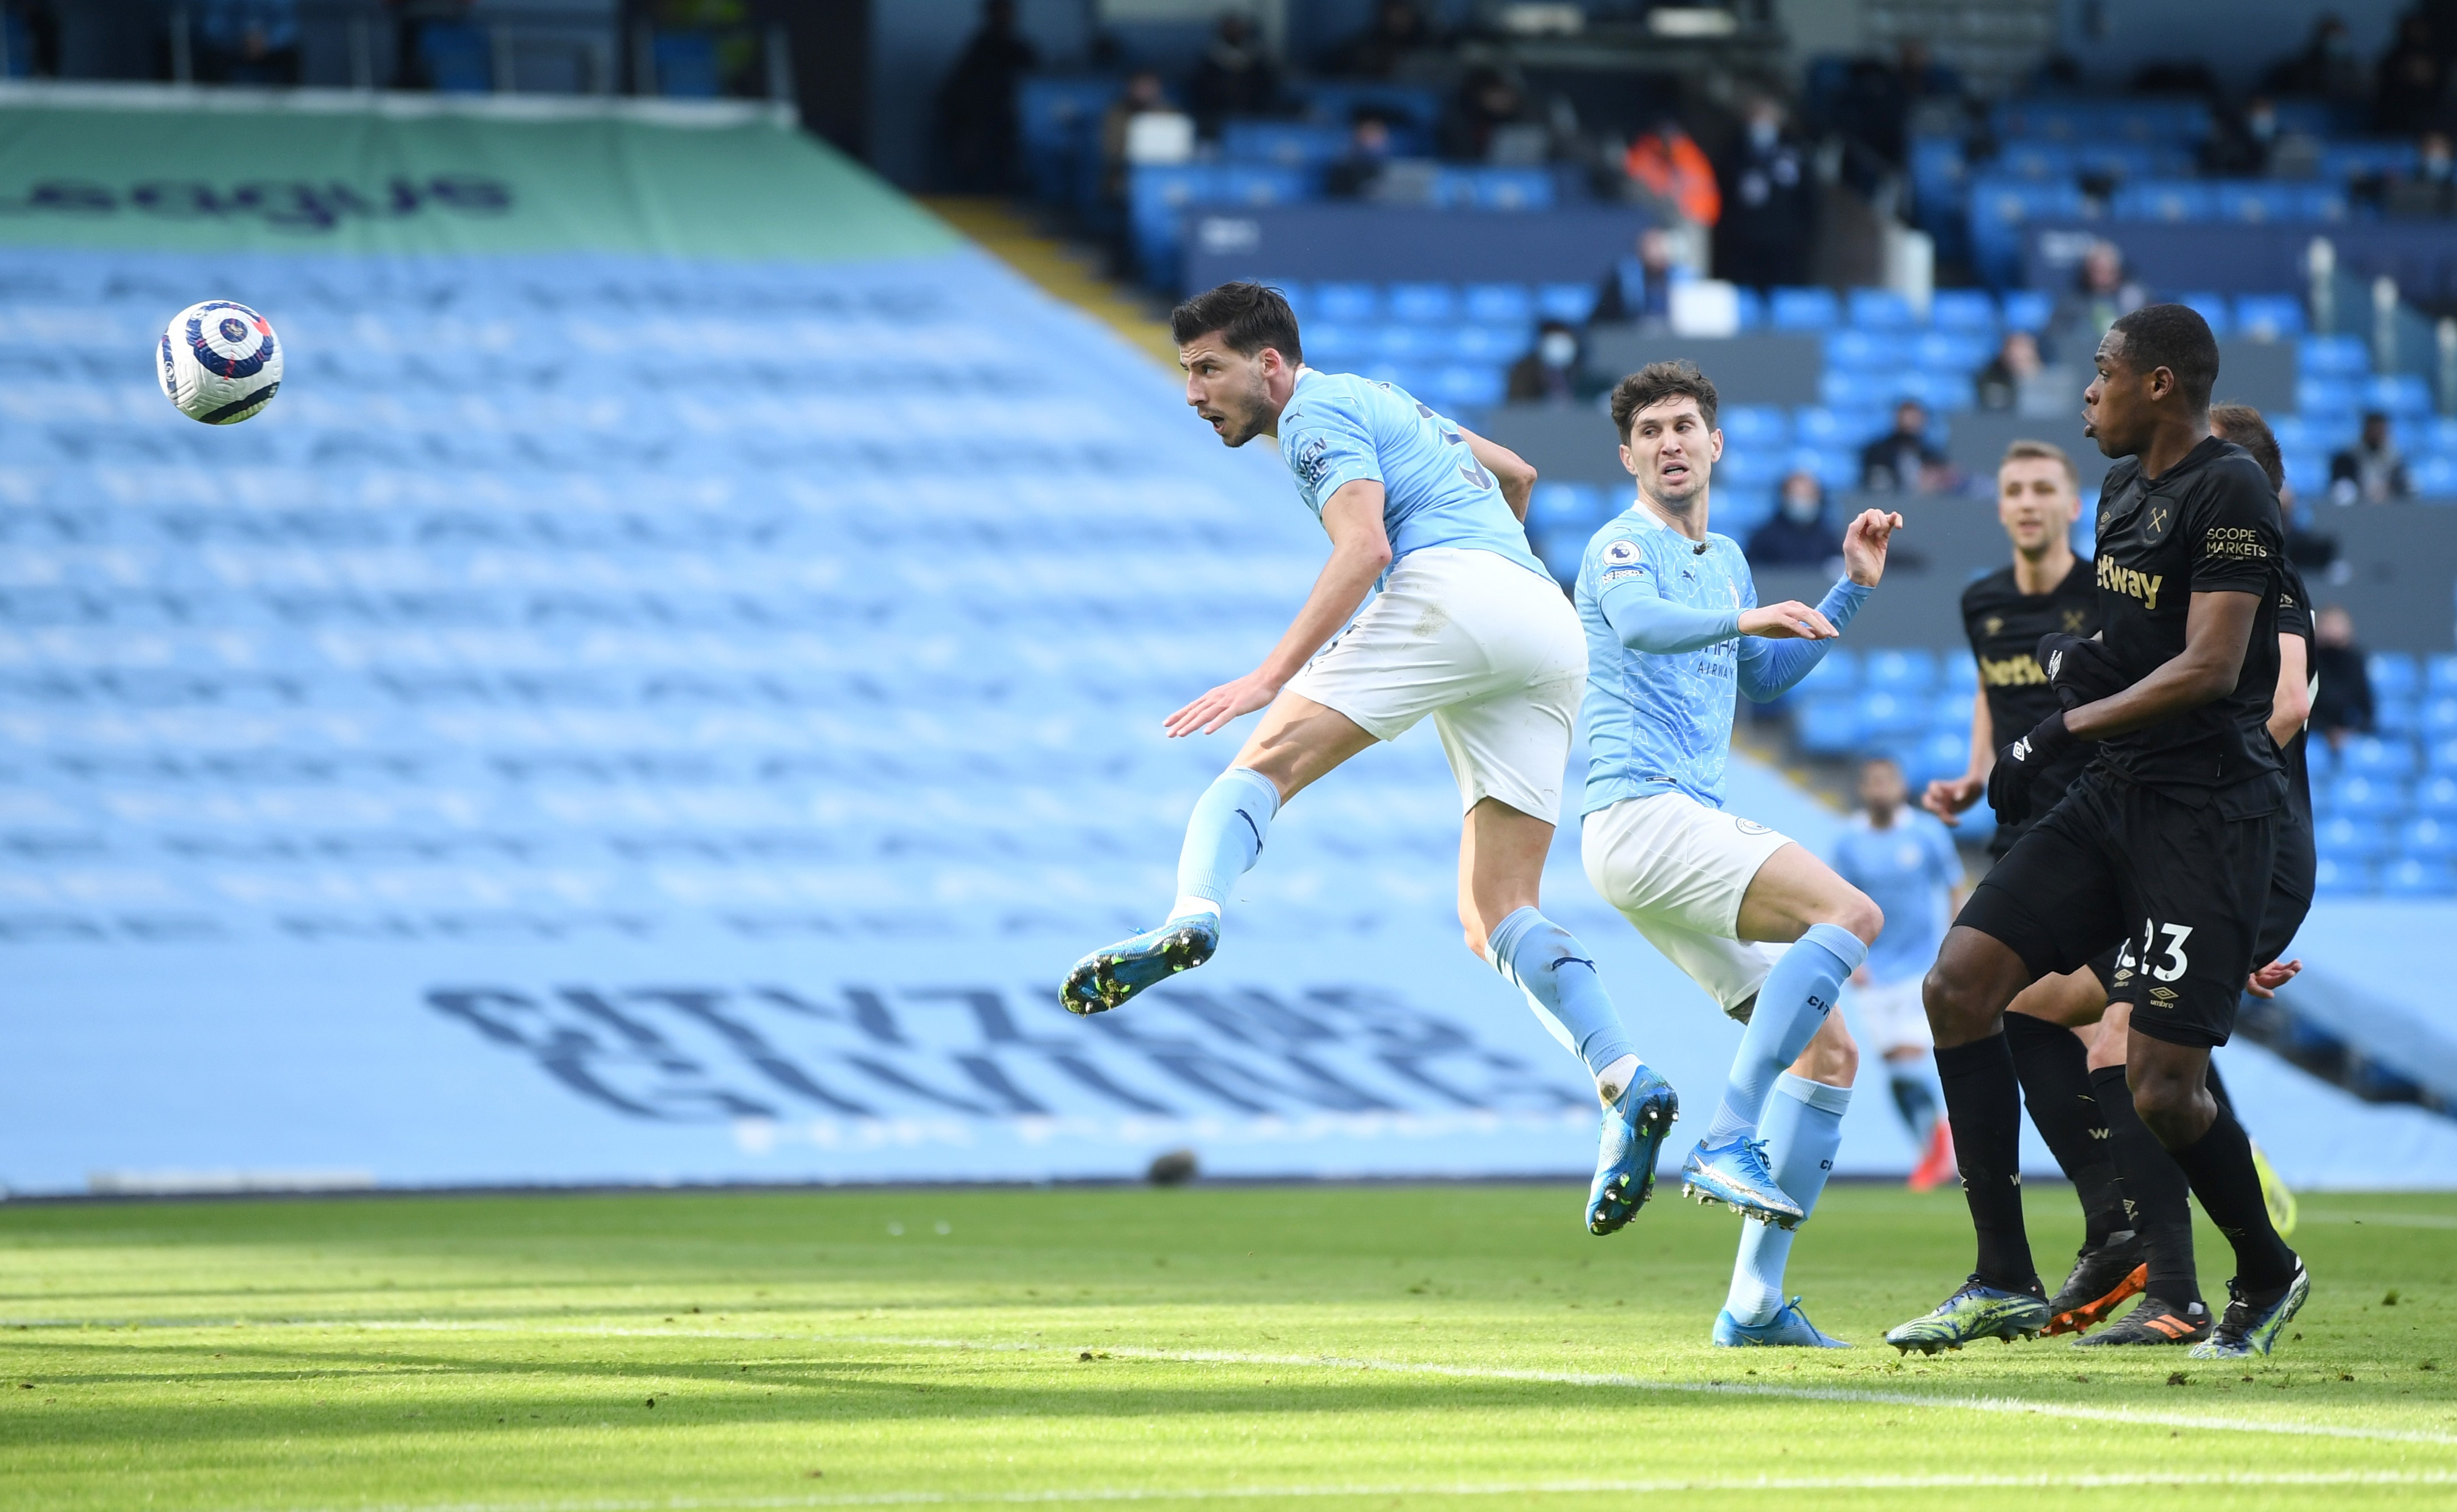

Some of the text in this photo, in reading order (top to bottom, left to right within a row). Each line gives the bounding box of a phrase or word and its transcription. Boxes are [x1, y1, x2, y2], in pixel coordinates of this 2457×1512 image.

[1299, 437, 1328, 480] XEN
[1308, 457, 1329, 486] RE
[2206, 528, 2256, 542] SCOPE
[2206, 541, 2267, 557] MARKETS
[2096, 554, 2163, 610] etway
[1697, 661, 1734, 680] AIRWAY
[1980, 654, 2049, 686] betw
[1807, 995, 1831, 1021] CIT
[2150, 999, 2174, 1009] umbro
[1819, 1159, 1834, 1171] CI
